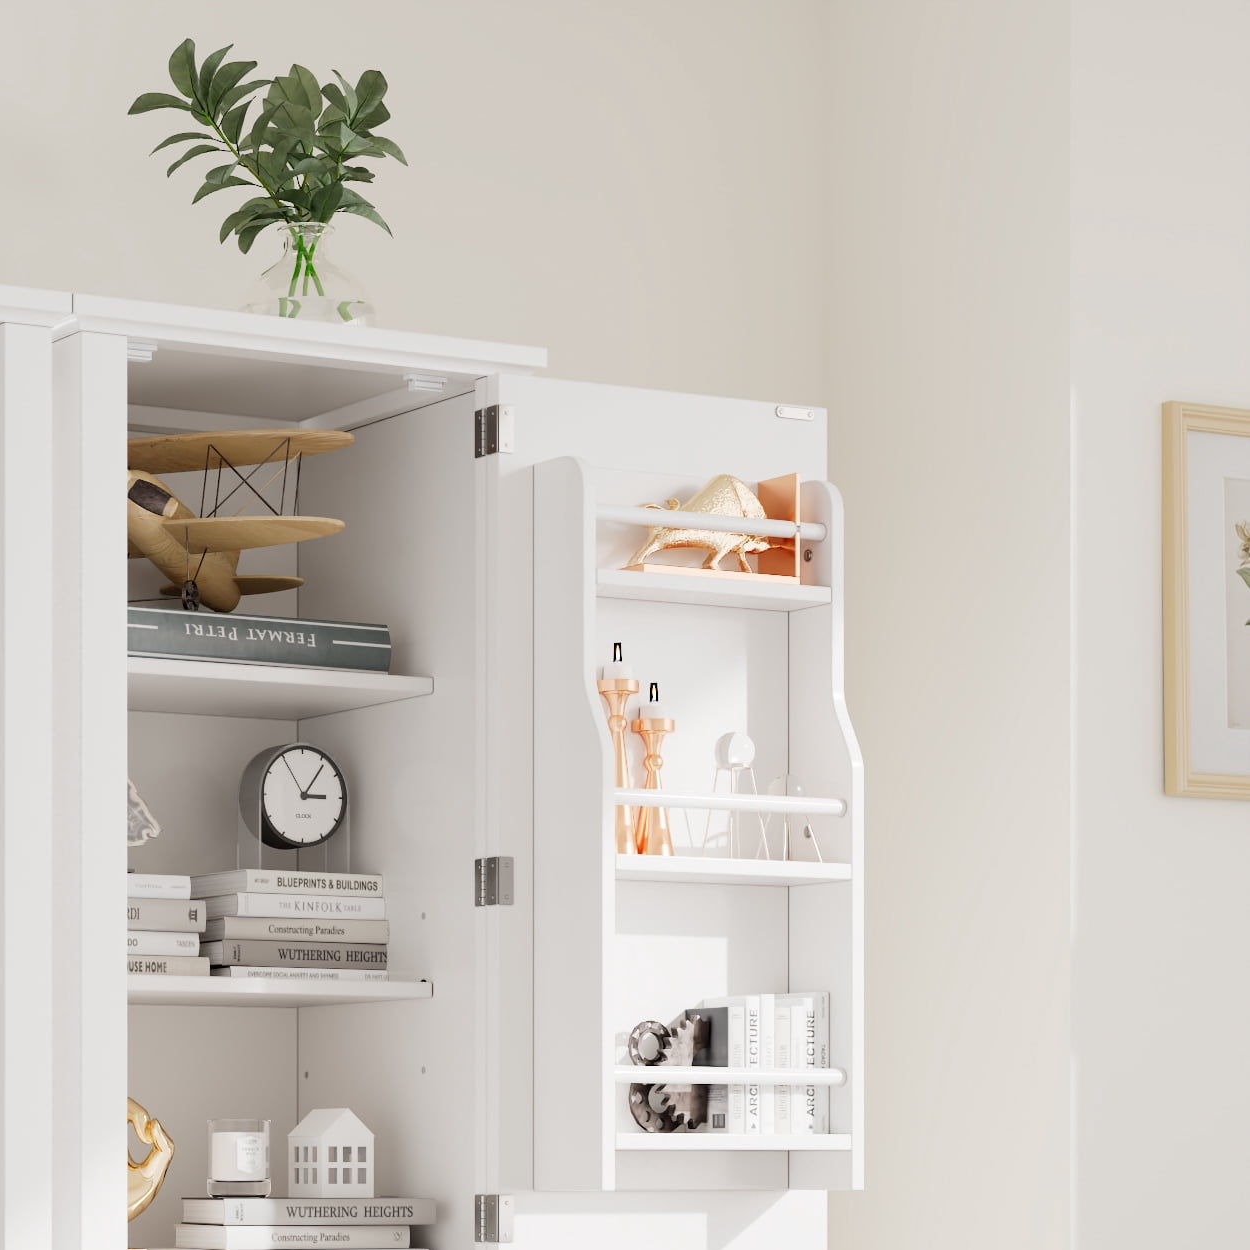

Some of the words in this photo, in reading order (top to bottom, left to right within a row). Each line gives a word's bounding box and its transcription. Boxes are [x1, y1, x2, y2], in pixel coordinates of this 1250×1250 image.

[185, 623, 238, 641] PETRI
[246, 628, 317, 647] FERMAT
[277, 877, 327, 889] BLUEPRINTS
[328, 879, 334, 889] &
[336, 880, 378, 892] BUILDINGS
[294, 900, 342, 913] KINFOLK
[268, 924, 314, 936] Constructing
[278, 948, 341, 962] WUTHERING
[345, 950, 387, 963] HEIGHTS
[145, 961, 167, 973] HOME
[286, 1206, 358, 1219] WUTHERING
[363, 1205, 414, 1218] HEIGHTS
[271, 1231, 318, 1243] Constructing
